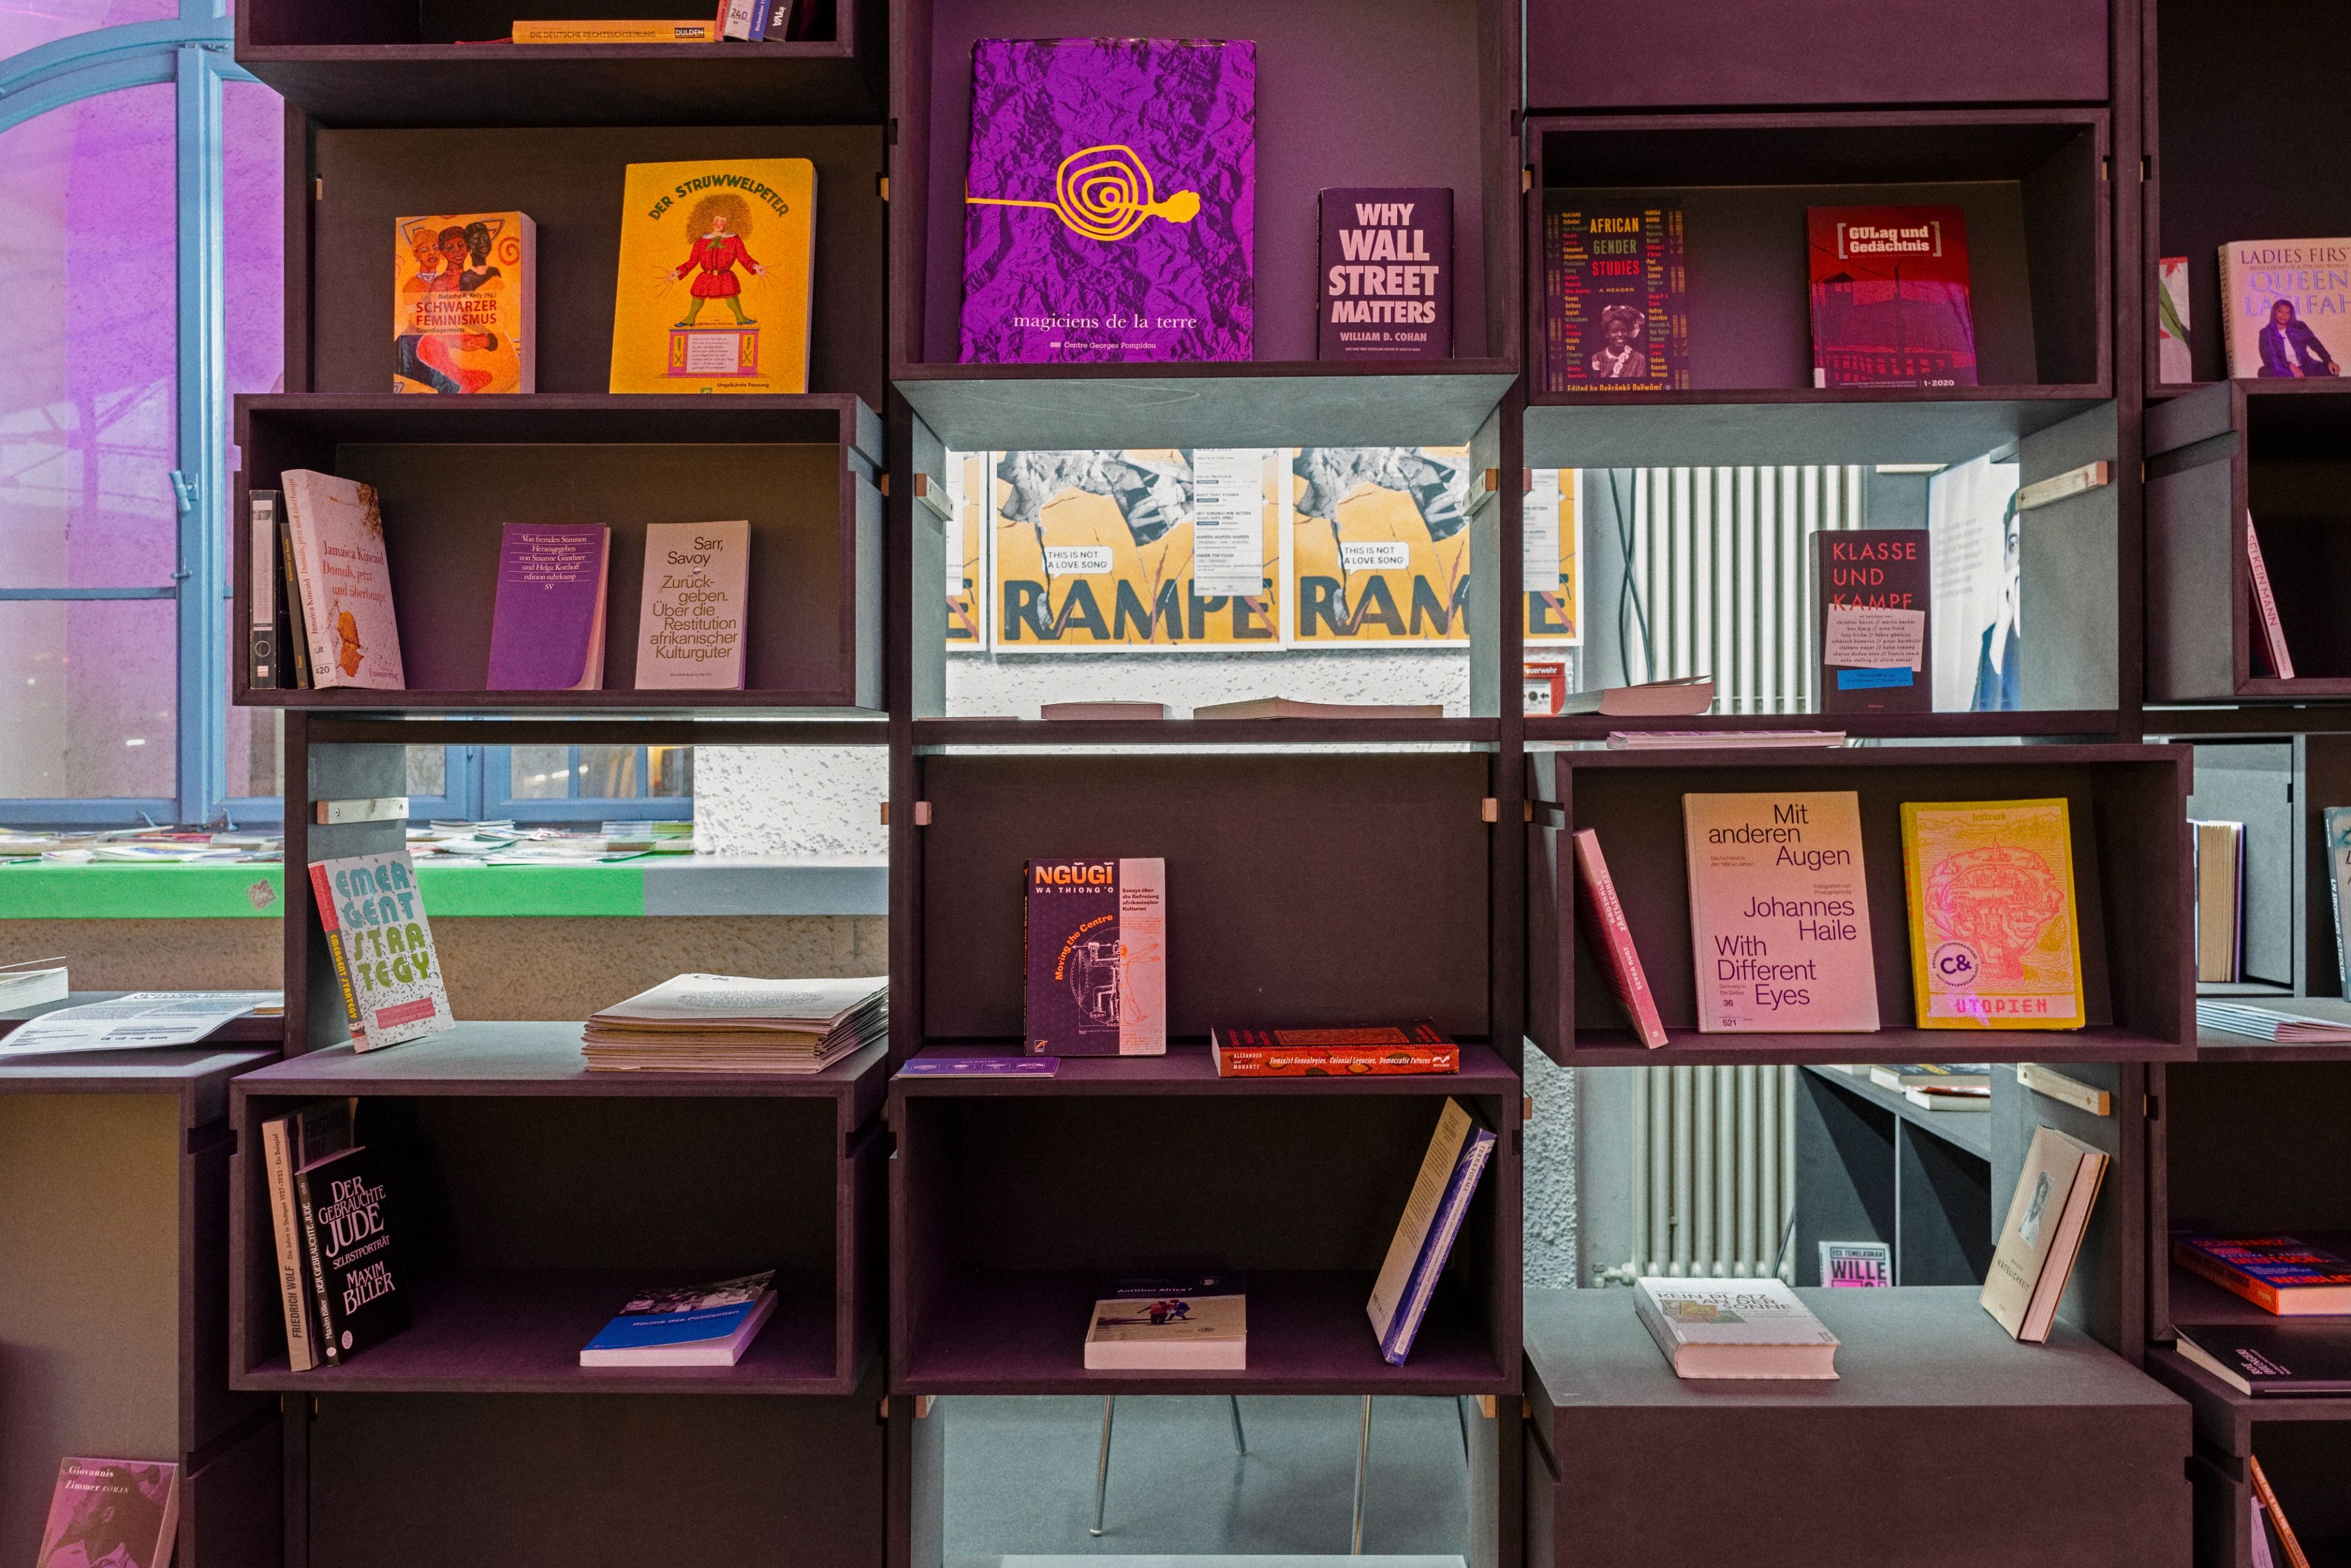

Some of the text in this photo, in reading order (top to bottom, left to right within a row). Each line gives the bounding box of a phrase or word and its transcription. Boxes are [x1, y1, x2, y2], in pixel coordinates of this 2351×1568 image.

[732, 9, 748, 19] 240
[648, 174, 789, 220] DER STRUWWELPETER
[1355, 203, 1414, 225] WHY
[1590, 217, 1639, 233] AFRICAN
[1849, 226, 1928, 241] GULag und
[1339, 230, 1430, 261] WALL
[1594, 239, 1637, 255] GENDER
[1850, 240, 1930, 253] Gedächtnis
[2241, 247, 2351, 264] LADIES FIRS
[1592, 260, 1640, 276] STUDIES
[1329, 265, 1439, 296] STREET
[2251, 269, 2349, 297] QUEEN
[416, 300, 497, 313] SCHWARZER
[1331, 301, 1435, 323] MATTERS
[416, 313, 497, 326] FEMINISMUS
[1014, 313, 1197, 332] magiciens de la terre
[1340, 332, 1427, 342] WILLIAM D. COHAN
[323, 541, 384, 565] Jamaica Kincaid
[694, 536, 723, 551] Sarr,
[1834, 542, 1916, 560] KLASSE
[667, 551, 710, 567] Savoy
[662, 575, 714, 588] Zurück-
[1834, 568, 1884, 585] UND
[2248, 535, 2278, 626] SEI KEIN MANN
[332, 585, 386, 607] und überhaupt
[679, 590, 727, 606] geben.
[1834, 593, 1912, 611] KAMPF
[653, 601, 715, 617] Über die
[1004, 579, 1273, 640] RAMPE
[665, 617, 736, 630] Restitution
[651, 631, 738, 645] afrikanischer
[656, 645, 732, 662] Kulturgüter
[315, 666, 329, 675] 420
[1774, 804, 1809, 824] Mit
[1709, 823, 1800, 844] anderen
[1776, 846, 1850, 871] Augen
[337, 863, 411, 898] EMER
[343, 892, 414, 929] GENT
[1744, 896, 1854, 917] Johannes
[1799, 919, 1856, 940] Haile
[354, 923, 426, 961] STRA
[1055, 914, 1113, 980] Moving the Centre
[1714, 936, 1766, 956] With
[358, 951, 429, 991] TEGY
[1718, 959, 1817, 980] Different
[1940, 954, 1971, 974] C&
[331, 934, 358, 1019] EMERGENT STRATEGY
[1755, 984, 1810, 1010] Eyes
[1956, 999, 2047, 1013] UTOPIEN
[1294, 1057, 1327, 1065] Genealogies,
[1353, 1057, 1376, 1065] Legacies,
[331, 1176, 366, 1203] DER
[318, 1185, 386, 1225] GEBRAUCHTE
[326, 1201, 384, 1258] JUDE
[333, 1235, 390, 1270] SELBSTPORTRÄT
[346, 1261, 385, 1289] MAXIM
[1831, 1260, 1886, 1280] WILLE
[1998, 1259, 2030, 1291] HÄSSLICHKEIT
[343, 1272, 396, 1316] BILLER
[687, 1310, 740, 1321] Politischen
[69, 1466, 114, 1477] Giovannis
[65, 1480, 100, 1491] Zimmer
